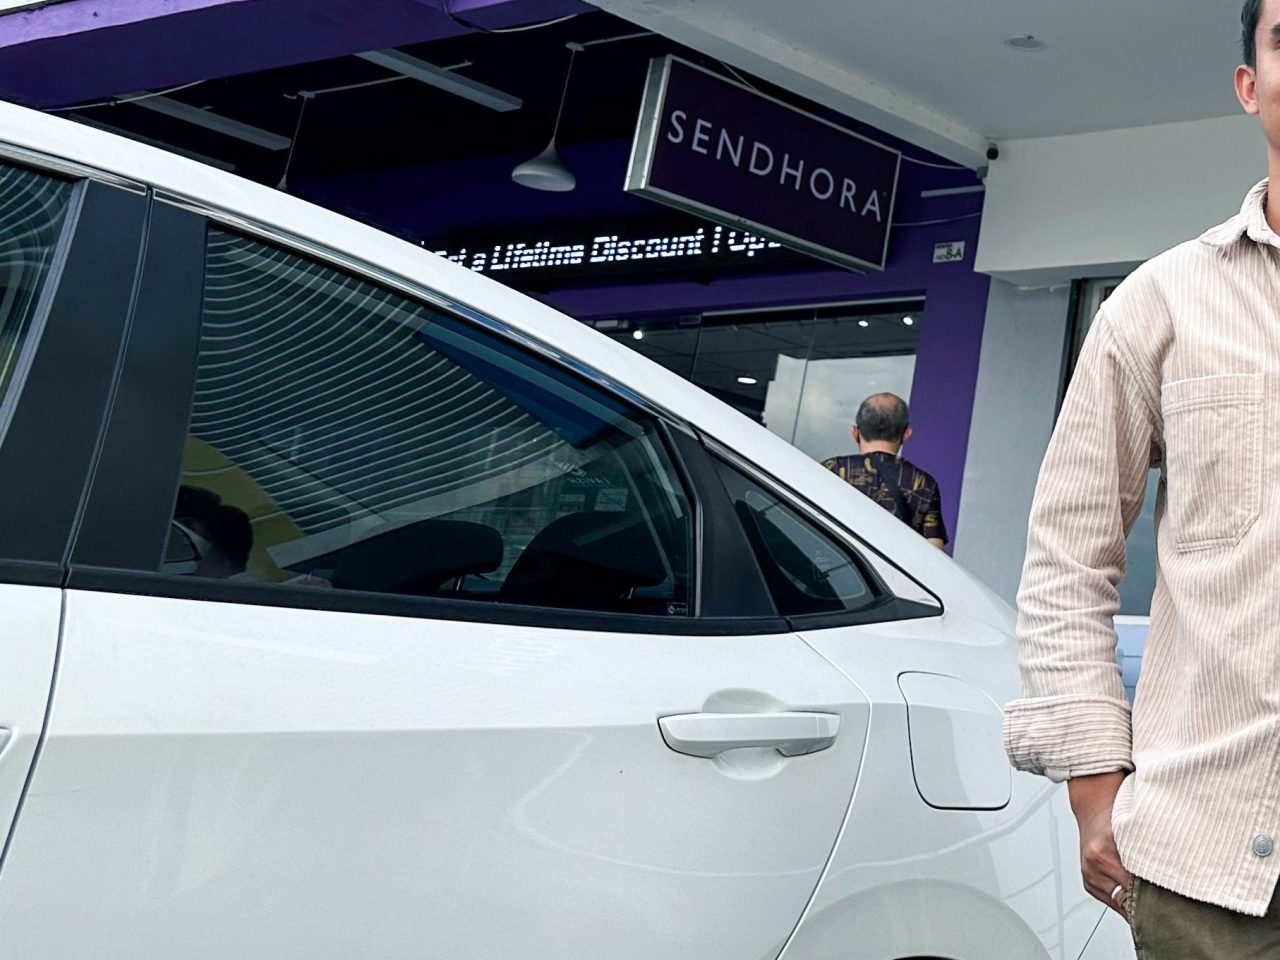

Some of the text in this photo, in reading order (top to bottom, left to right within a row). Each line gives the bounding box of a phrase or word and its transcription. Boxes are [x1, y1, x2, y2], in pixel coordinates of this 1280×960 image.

[667, 110, 882, 223] SENDHORA
[490, 241, 585, 270] Lifetime
[590, 228, 704, 262] Discount
